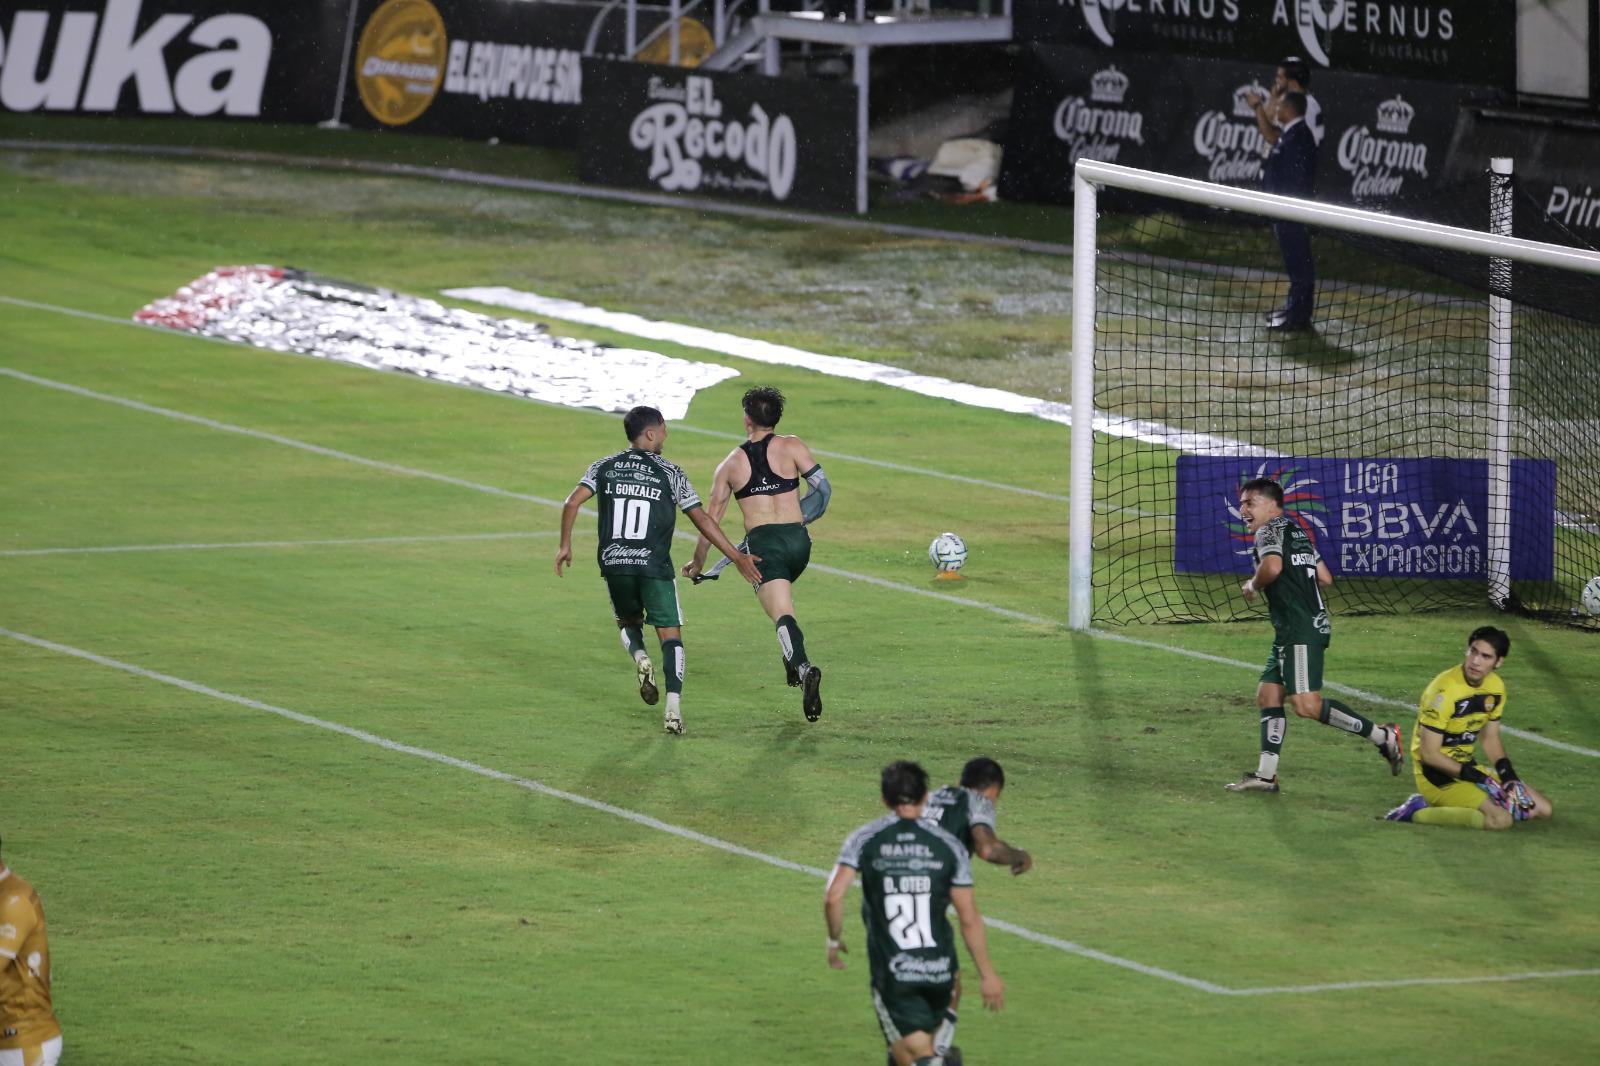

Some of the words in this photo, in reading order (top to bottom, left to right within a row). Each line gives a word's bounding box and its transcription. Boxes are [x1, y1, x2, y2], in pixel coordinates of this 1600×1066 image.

[0, 0, 272, 116] uka
[686, 76, 722, 117] EL
[1054, 97, 1144, 146] Corona
[1209, 150, 1261, 181] Golden
[1337, 125, 1428, 178] Corona
[1352, 168, 1404, 196] Golden
[614, 461, 654, 473] NAHEL
[1344, 462, 1398, 494] LIGA
[605, 483, 613, 494] J.
[616, 483, 661, 500] GONZALEZ
[612, 498, 650, 540] 10
[1341, 498, 1479, 539] BBVA
[602, 543, 652, 561] Caliente
[605, 557, 648, 566] caliente.mx
[884, 893, 937, 950] 21
